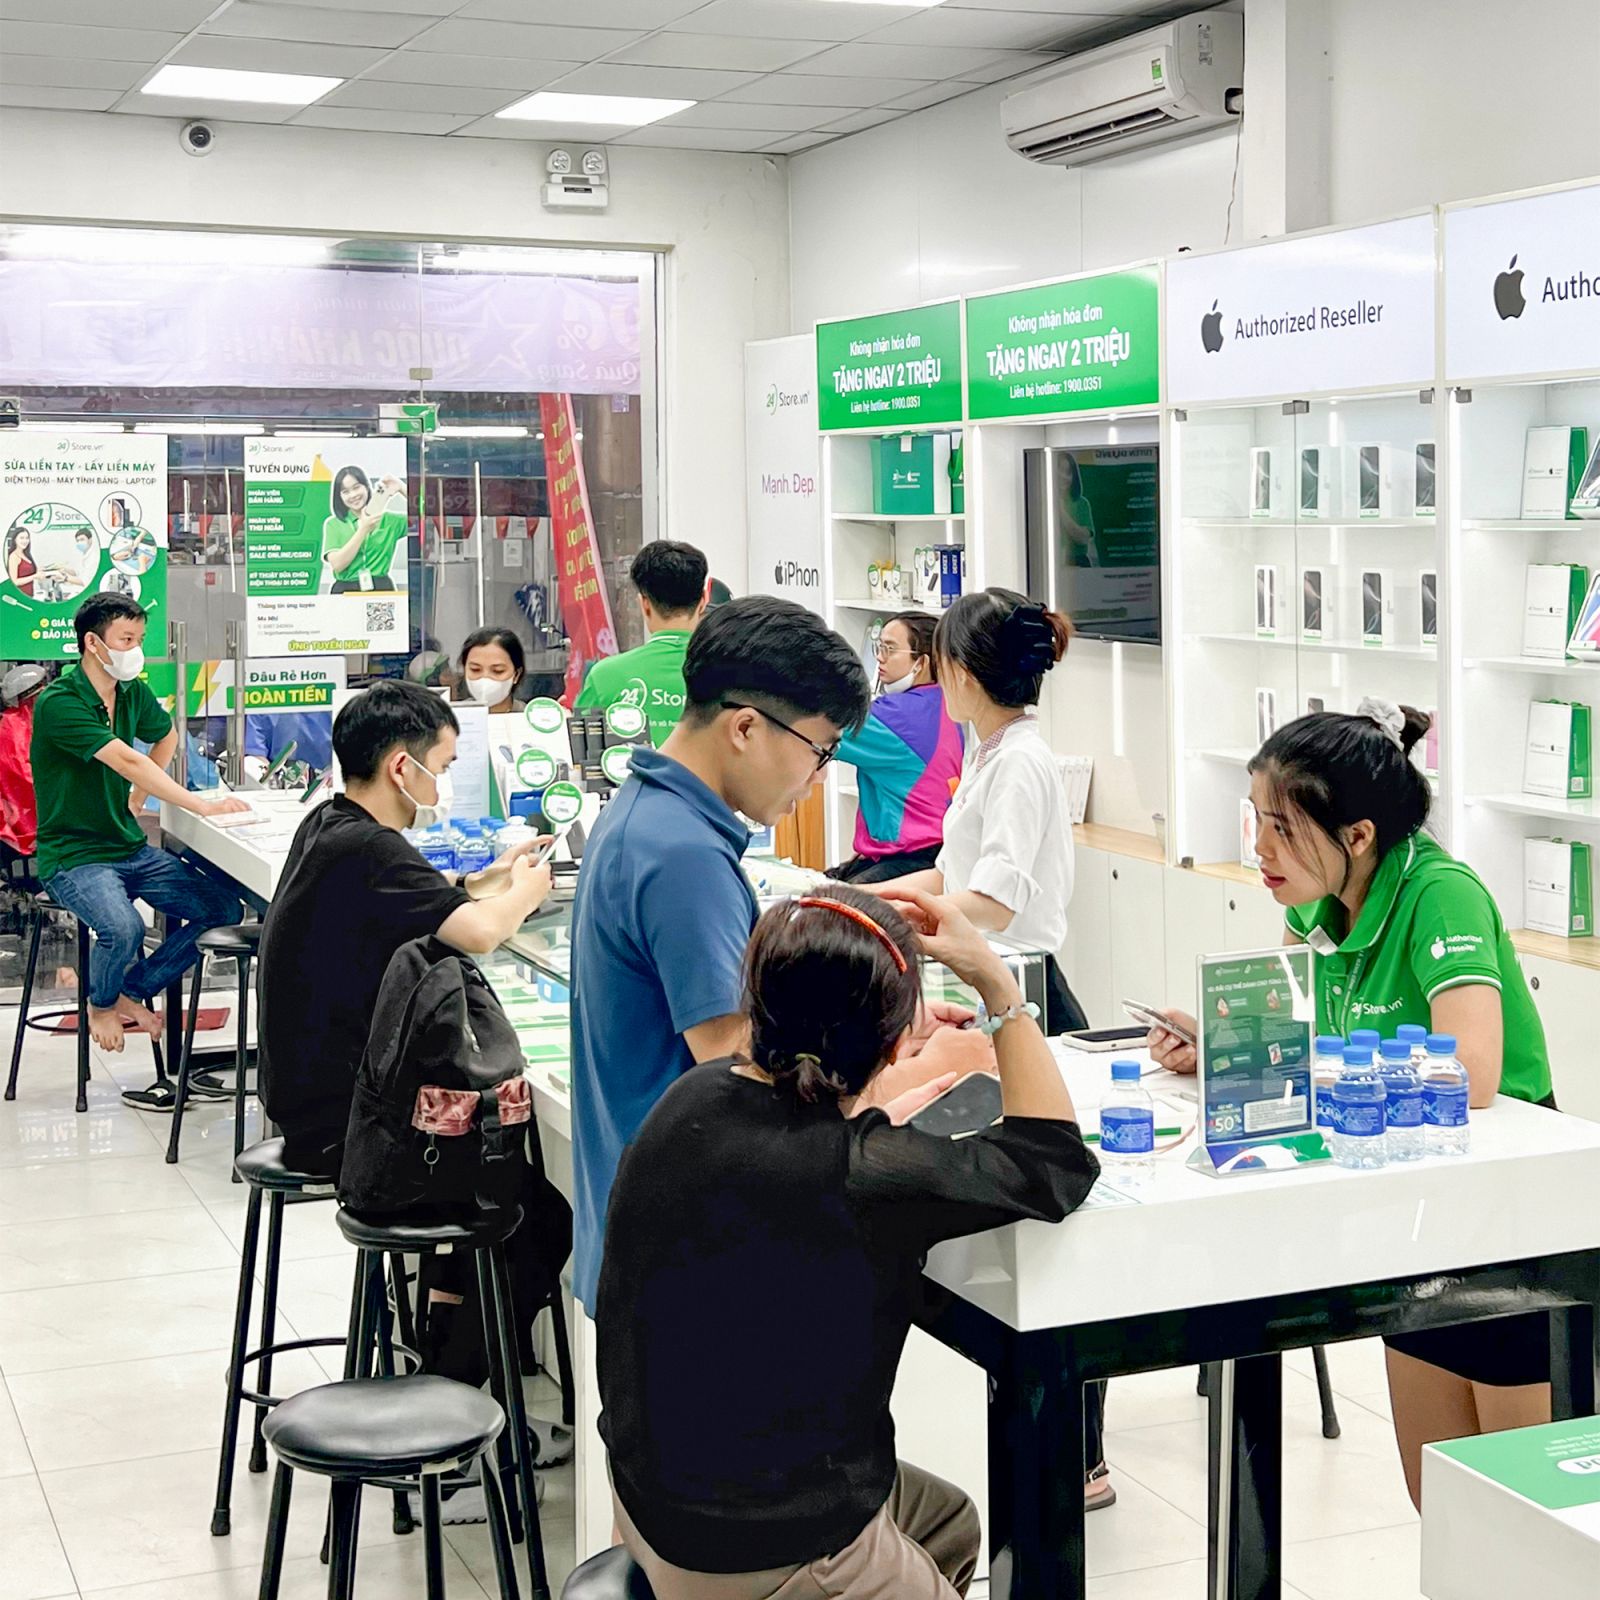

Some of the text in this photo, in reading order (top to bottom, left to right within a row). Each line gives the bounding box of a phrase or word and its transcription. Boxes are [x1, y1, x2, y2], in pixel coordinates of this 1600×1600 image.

[1008, 304, 1103, 334] Không nhận hóa đơn
[1235, 300, 1384, 340] Authorized Reseller
[849, 332, 920, 358] Không nhận hóa đơn
[986, 326, 1130, 381] TẶNG NGAY 2 TRIỆU
[833, 353, 941, 397] TẶNG NGAY 2 TRIỆU
[1010, 376, 1102, 399] Liên hệ hotline: 1900.0351
[779, 391, 810, 407] Store.vn
[851, 401, 862, 413] Liên
[863, 400, 870, 414] hệ
[5, 458, 25, 471] SỬA
[56, 463, 75, 471] TAY
[85, 459, 104, 471] LẤY
[133, 460, 156, 471] MÁY
[283, 465, 310, 475] DỤNG
[57, 475, 74, 484] MÁY
[126, 477, 156, 485] LAPTOP
[793, 474, 816, 498] Đẹp.
[24, 509, 81, 524] 24 Store
[785, 561, 819, 587] iPhon
[51, 617, 66, 627] GIÁ
[42, 629, 60, 639] BẢO
[344, 640, 370, 650] NGAY
[250, 671, 327, 682] Đâu Rẻ Hơn
[621, 688, 639, 705] 24
[1362, 996, 1404, 1014] Store.vn
